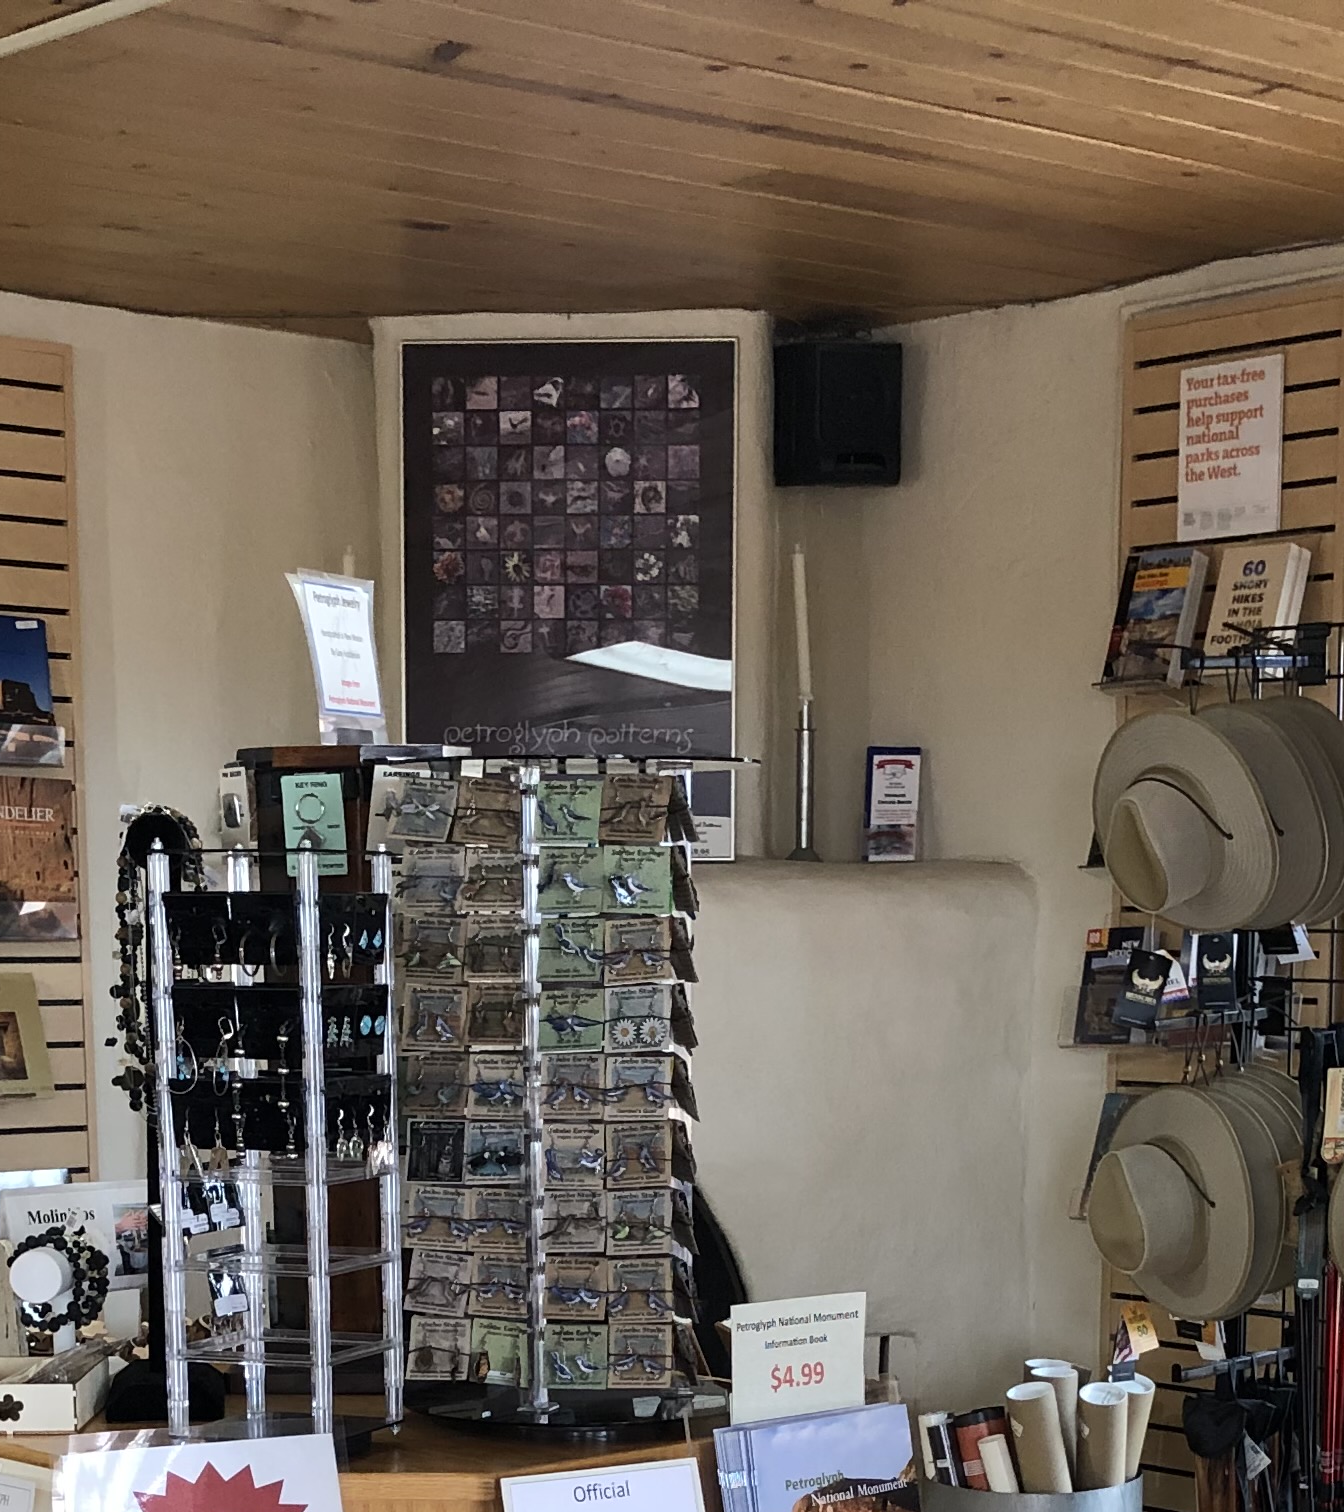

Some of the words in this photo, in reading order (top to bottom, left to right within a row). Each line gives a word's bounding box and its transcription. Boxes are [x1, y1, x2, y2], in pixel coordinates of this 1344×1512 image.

[1186, 377, 1215, 391] Your
[1217, 369, 1265, 387] tax-free
[1186, 389, 1249, 411] purchases
[1186, 412, 1214, 431] help
[1216, 405, 1264, 426] support
[1186, 427, 1240, 446] national
[1185, 451, 1219, 469] parks
[1222, 444, 1261, 460] across
[1185, 466, 1205, 483] the
[1207, 464, 1241, 479] West.
[1242, 560, 1267, 576] 60
[1232, 592, 1264, 604] HIKES
[1228, 607, 1240, 617] IN
[1242, 606, 1262, 617] THE
[443, 721, 583, 754] petroglyph
[588, 723, 695, 754] patterns
[736, 1318, 777, 1333] Petroglyph
[778, 1313, 812, 1327] National
[813, 1309, 859, 1323] Monument
[764, 1334, 808, 1350] Information
[809, 1333, 828, 1345] Book
[770, 1361, 825, 1393] $4.99
[785, 1470, 845, 1491] Petroglyph
[573, 1480, 631, 1504] Official
[811, 1489, 854, 1507] National
[856, 1477, 908, 1498] Monument
